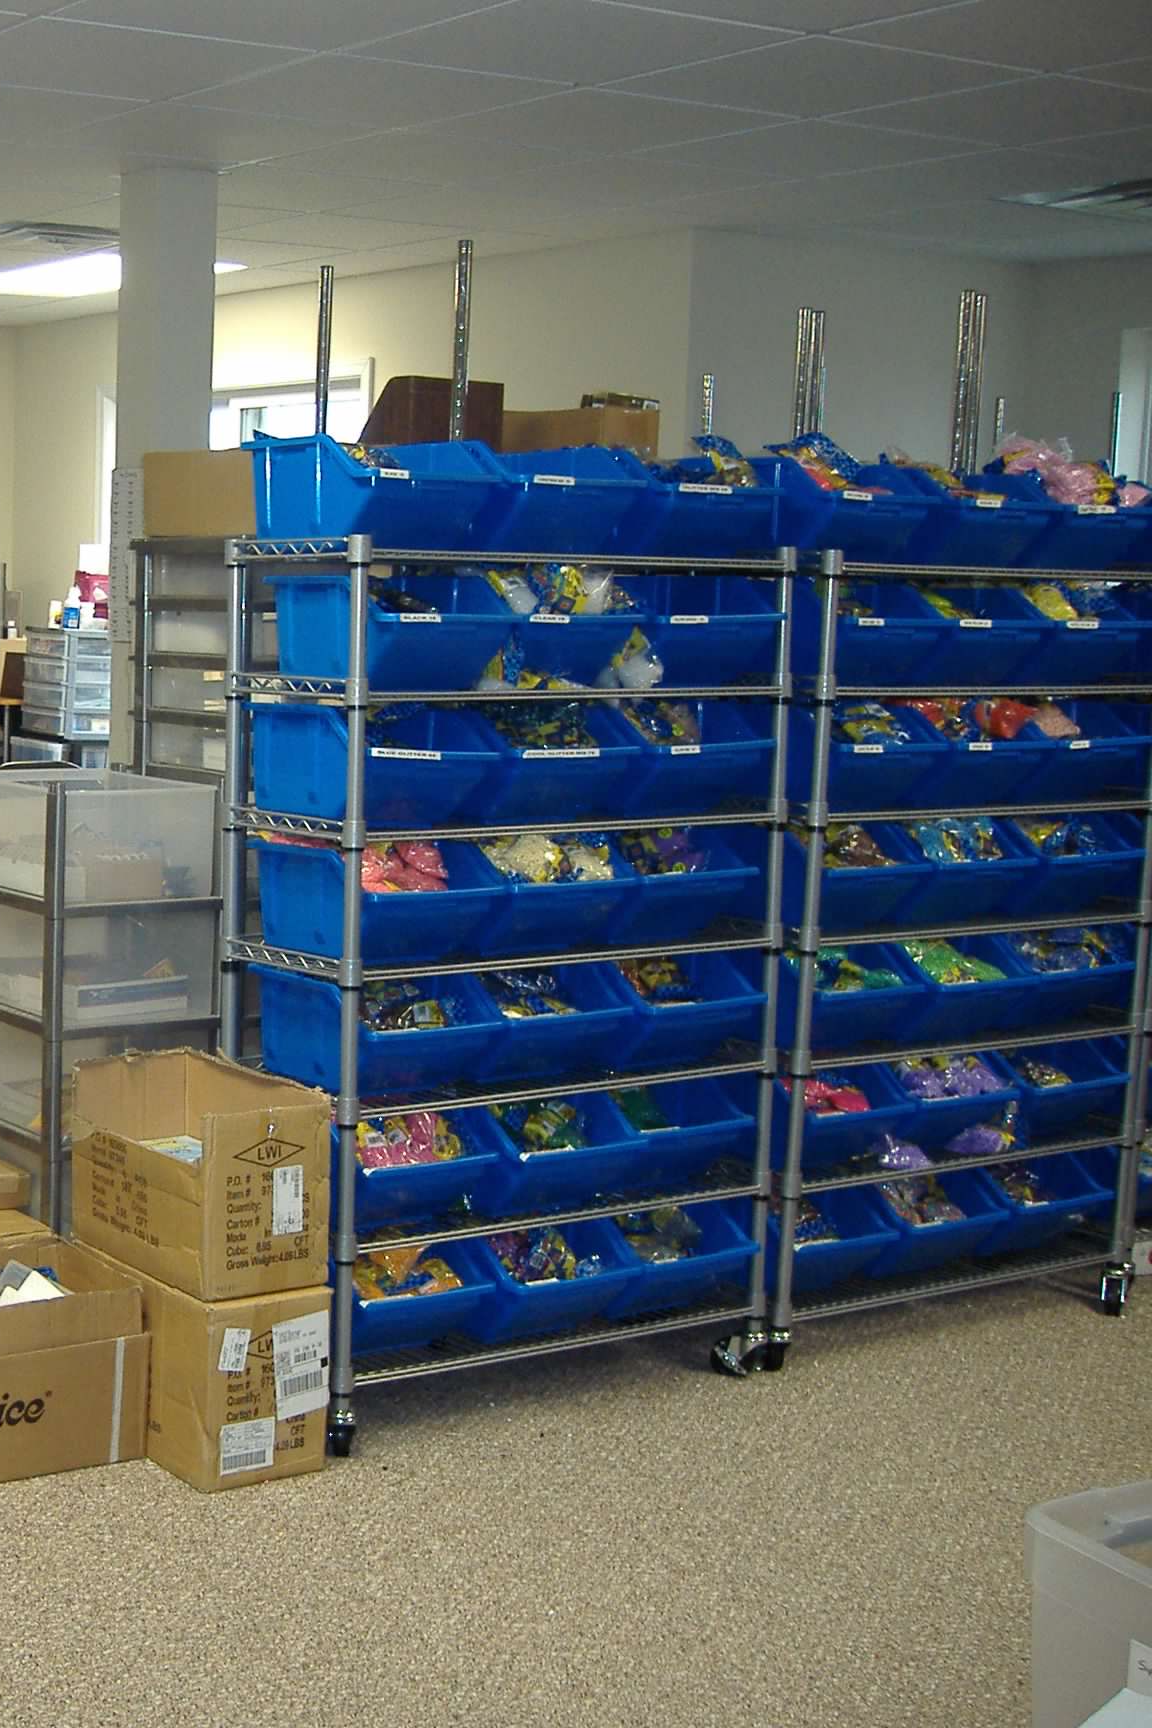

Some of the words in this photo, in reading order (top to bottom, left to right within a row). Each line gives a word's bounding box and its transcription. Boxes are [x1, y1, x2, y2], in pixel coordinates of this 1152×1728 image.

[257, 1144, 282, 1161] LWI
[226, 1260, 249, 1271] Gross
[258, 1336, 273, 1352] LW
